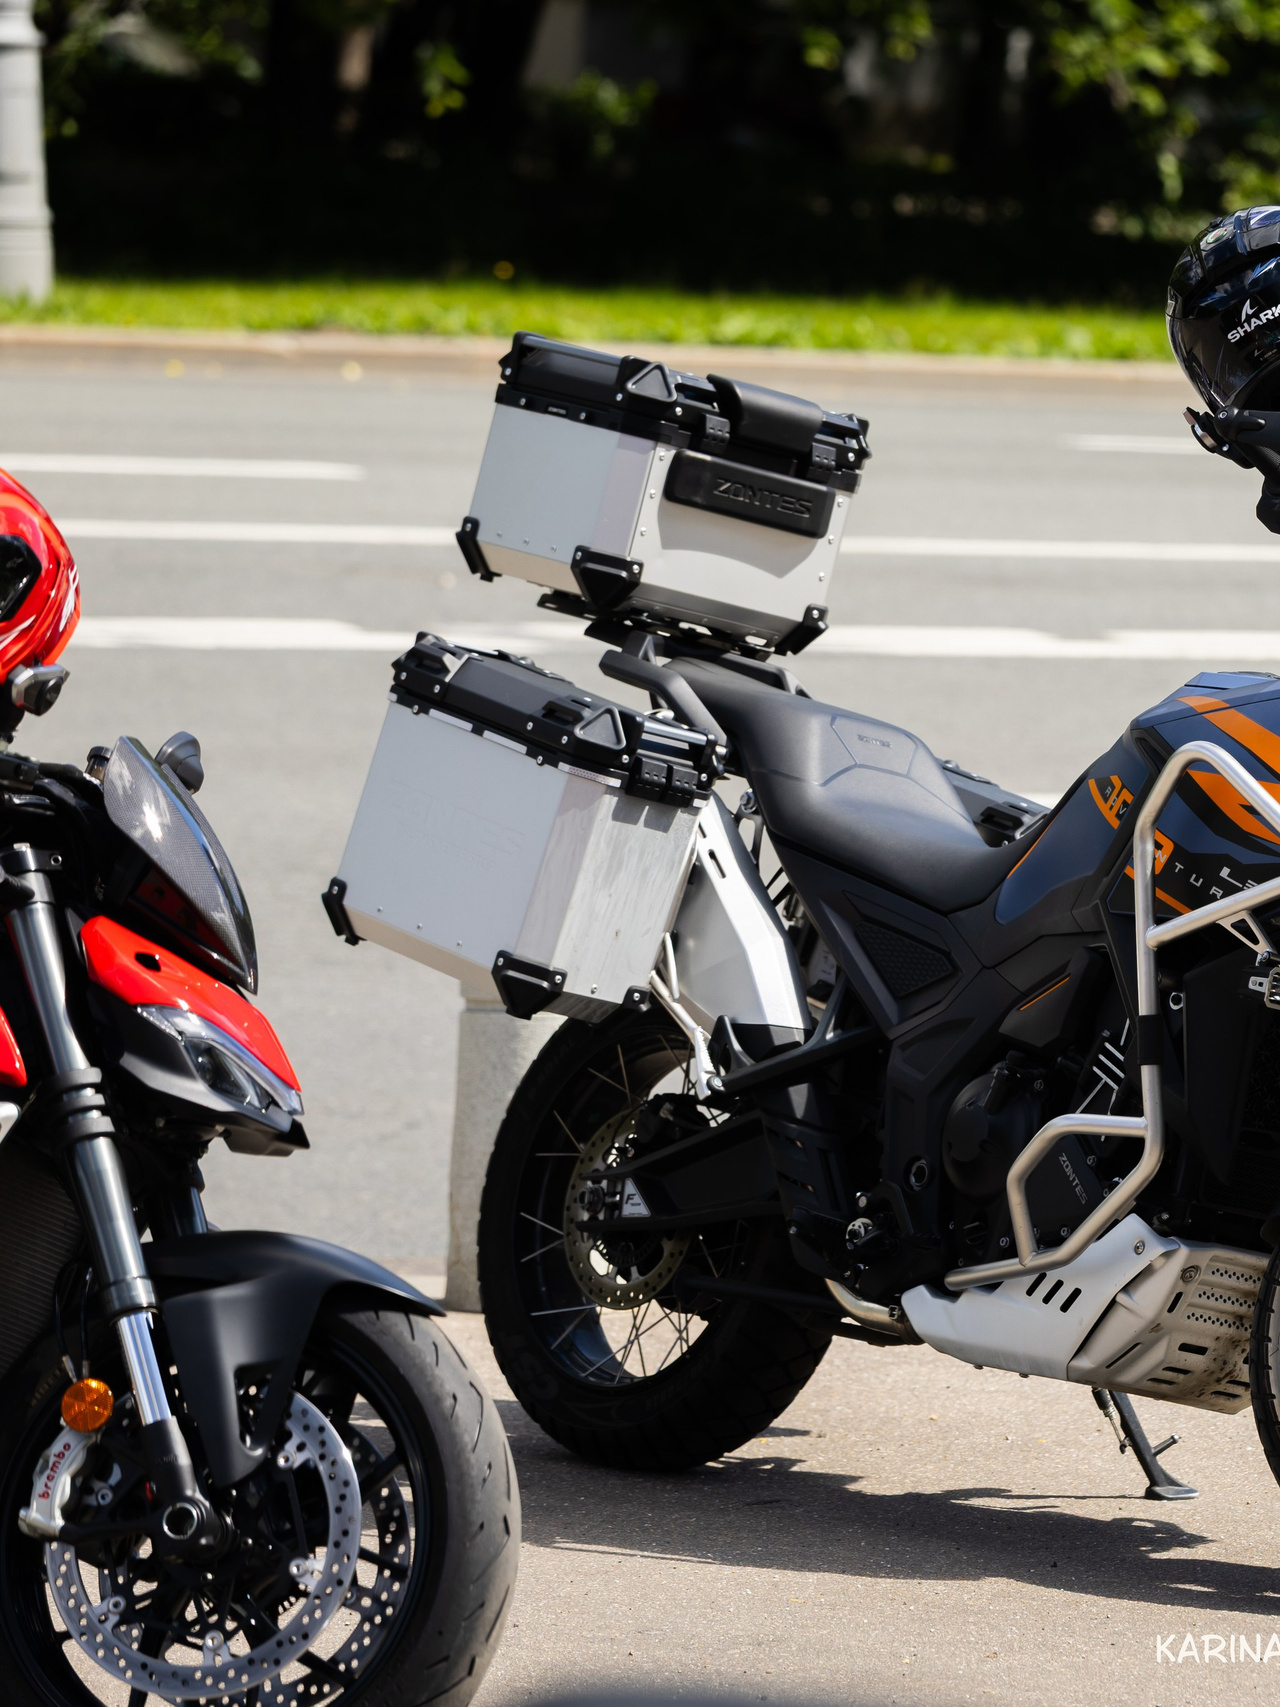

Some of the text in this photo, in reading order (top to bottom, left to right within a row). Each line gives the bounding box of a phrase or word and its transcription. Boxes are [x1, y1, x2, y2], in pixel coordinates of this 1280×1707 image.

[713, 479, 813, 518] ZONTES
[1059, 1152, 1088, 1205] ZONTES
[37, 1442, 72, 1501] brembo
